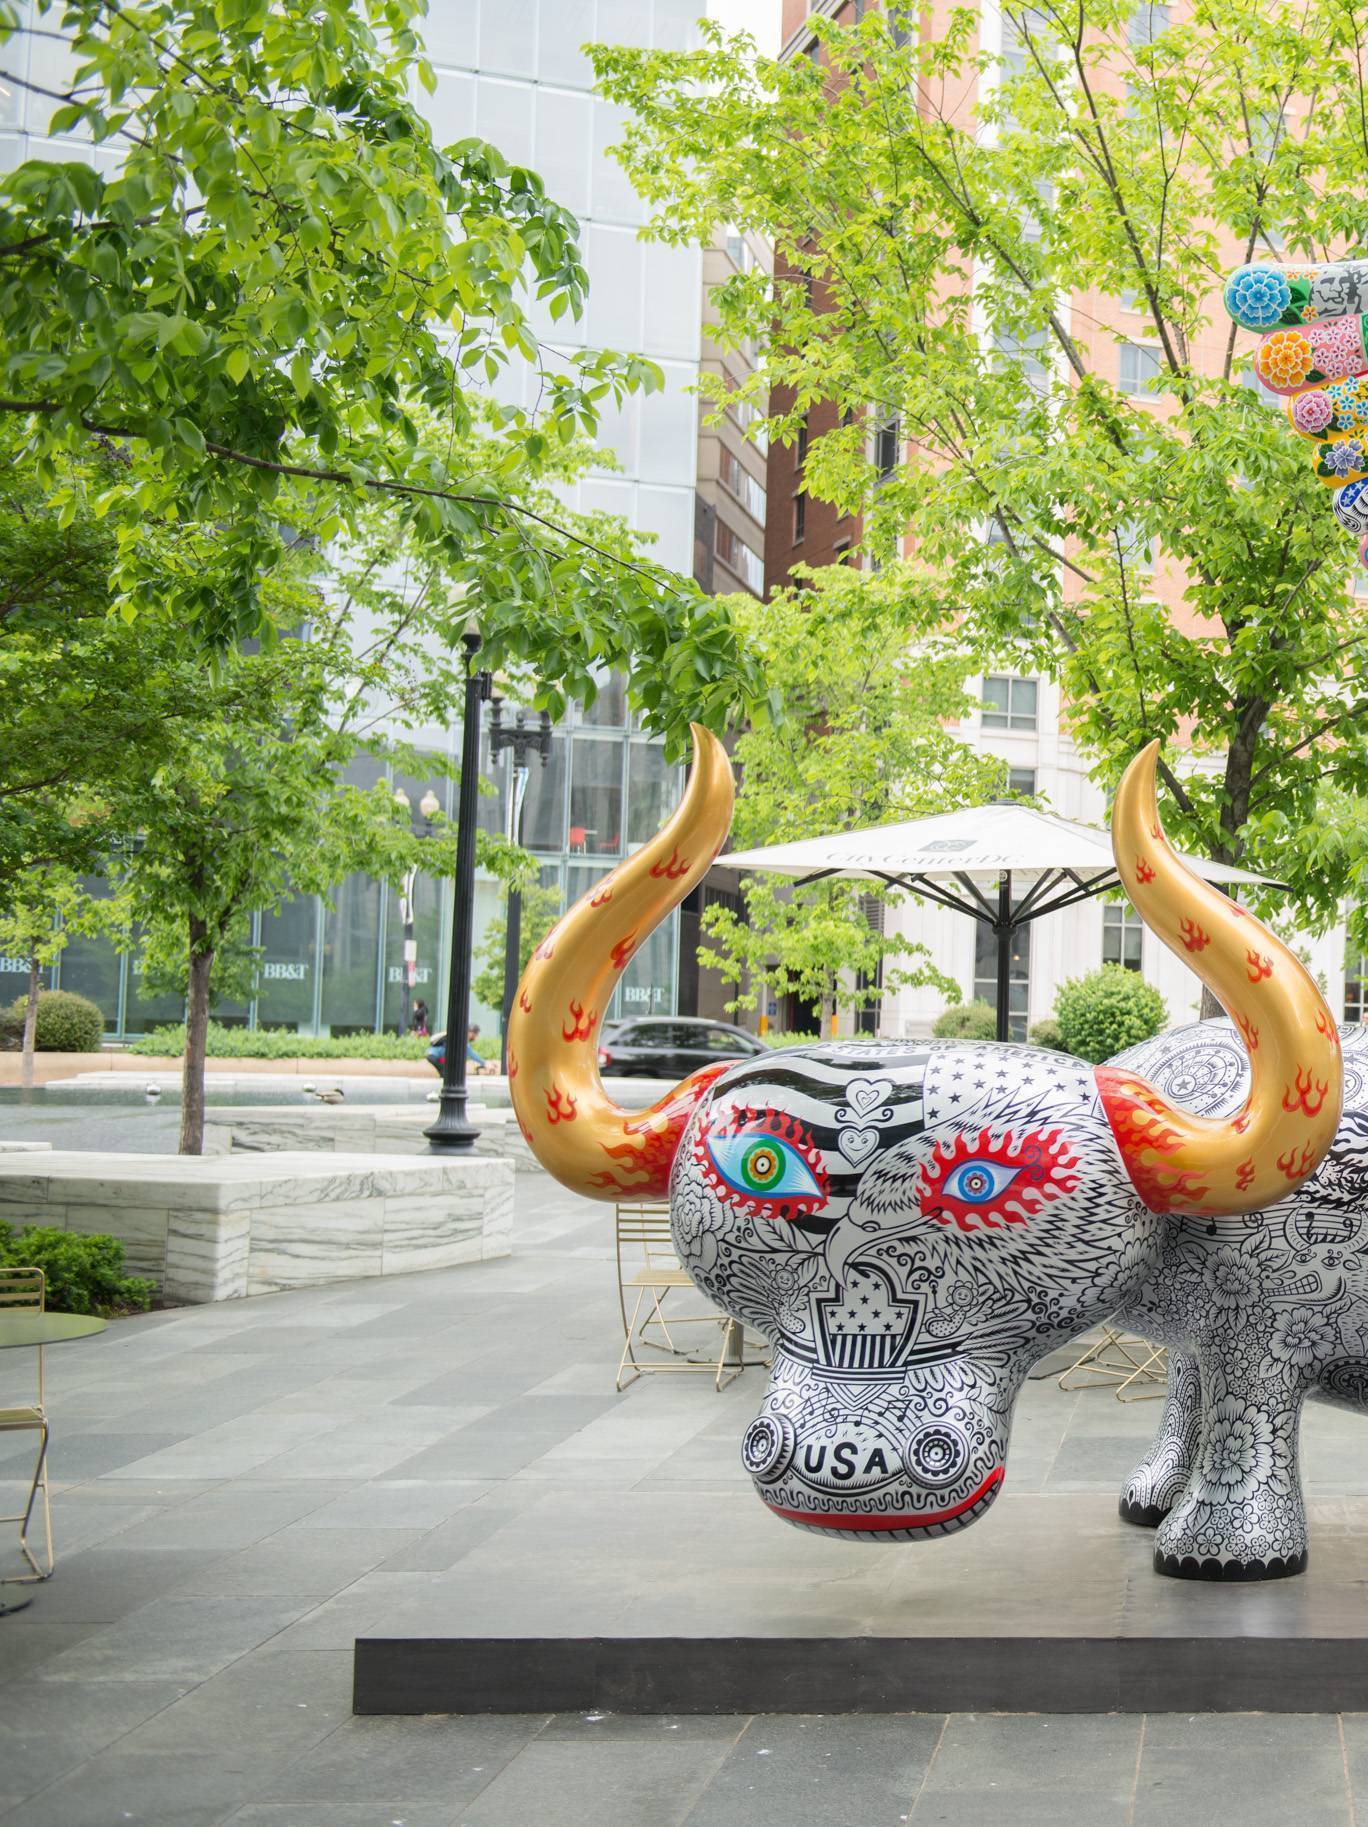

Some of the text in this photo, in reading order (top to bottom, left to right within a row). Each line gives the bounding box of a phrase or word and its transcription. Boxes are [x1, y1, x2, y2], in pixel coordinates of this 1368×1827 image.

[0, 957, 45, 974] BB&
[263, 963, 310, 980] BB&T
[624, 986, 665, 1003] BB&T
[929, 1043, 957, 1052] OF
[975, 1045, 1087, 1069] AMERICA
[804, 1441, 889, 1480] USA
